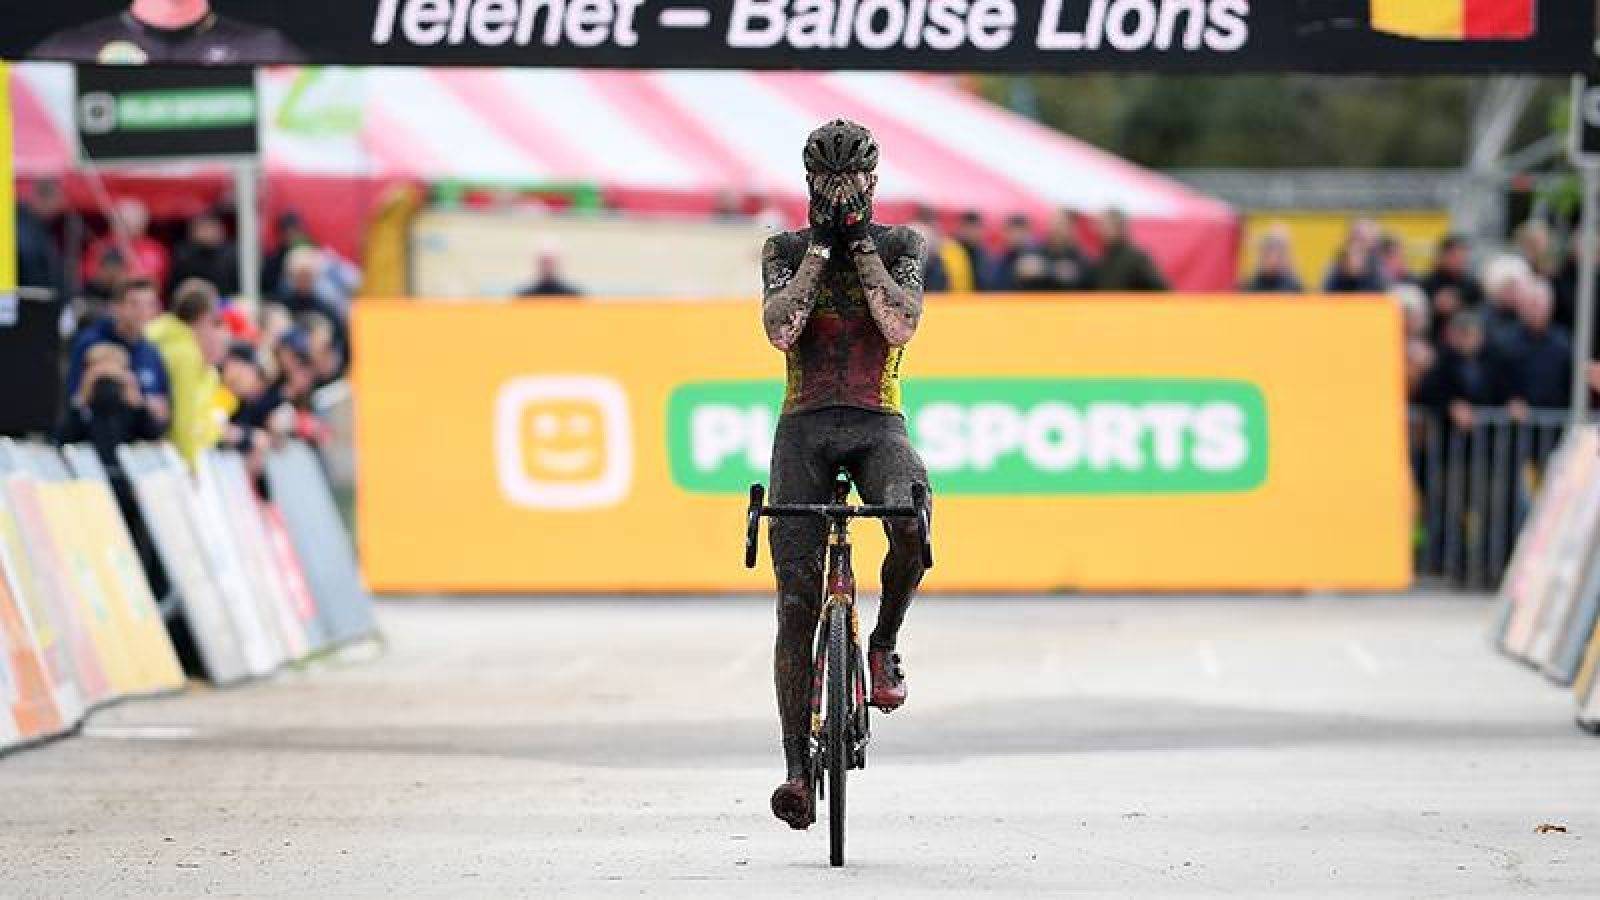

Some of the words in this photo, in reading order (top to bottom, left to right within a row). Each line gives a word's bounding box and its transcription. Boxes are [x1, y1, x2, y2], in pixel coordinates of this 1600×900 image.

[371, 0, 640, 46] Telenet
[727, 0, 1016, 48] Baloise
[1037, 0, 1250, 49] Lions
[917, 402, 1248, 470] SPORTS
